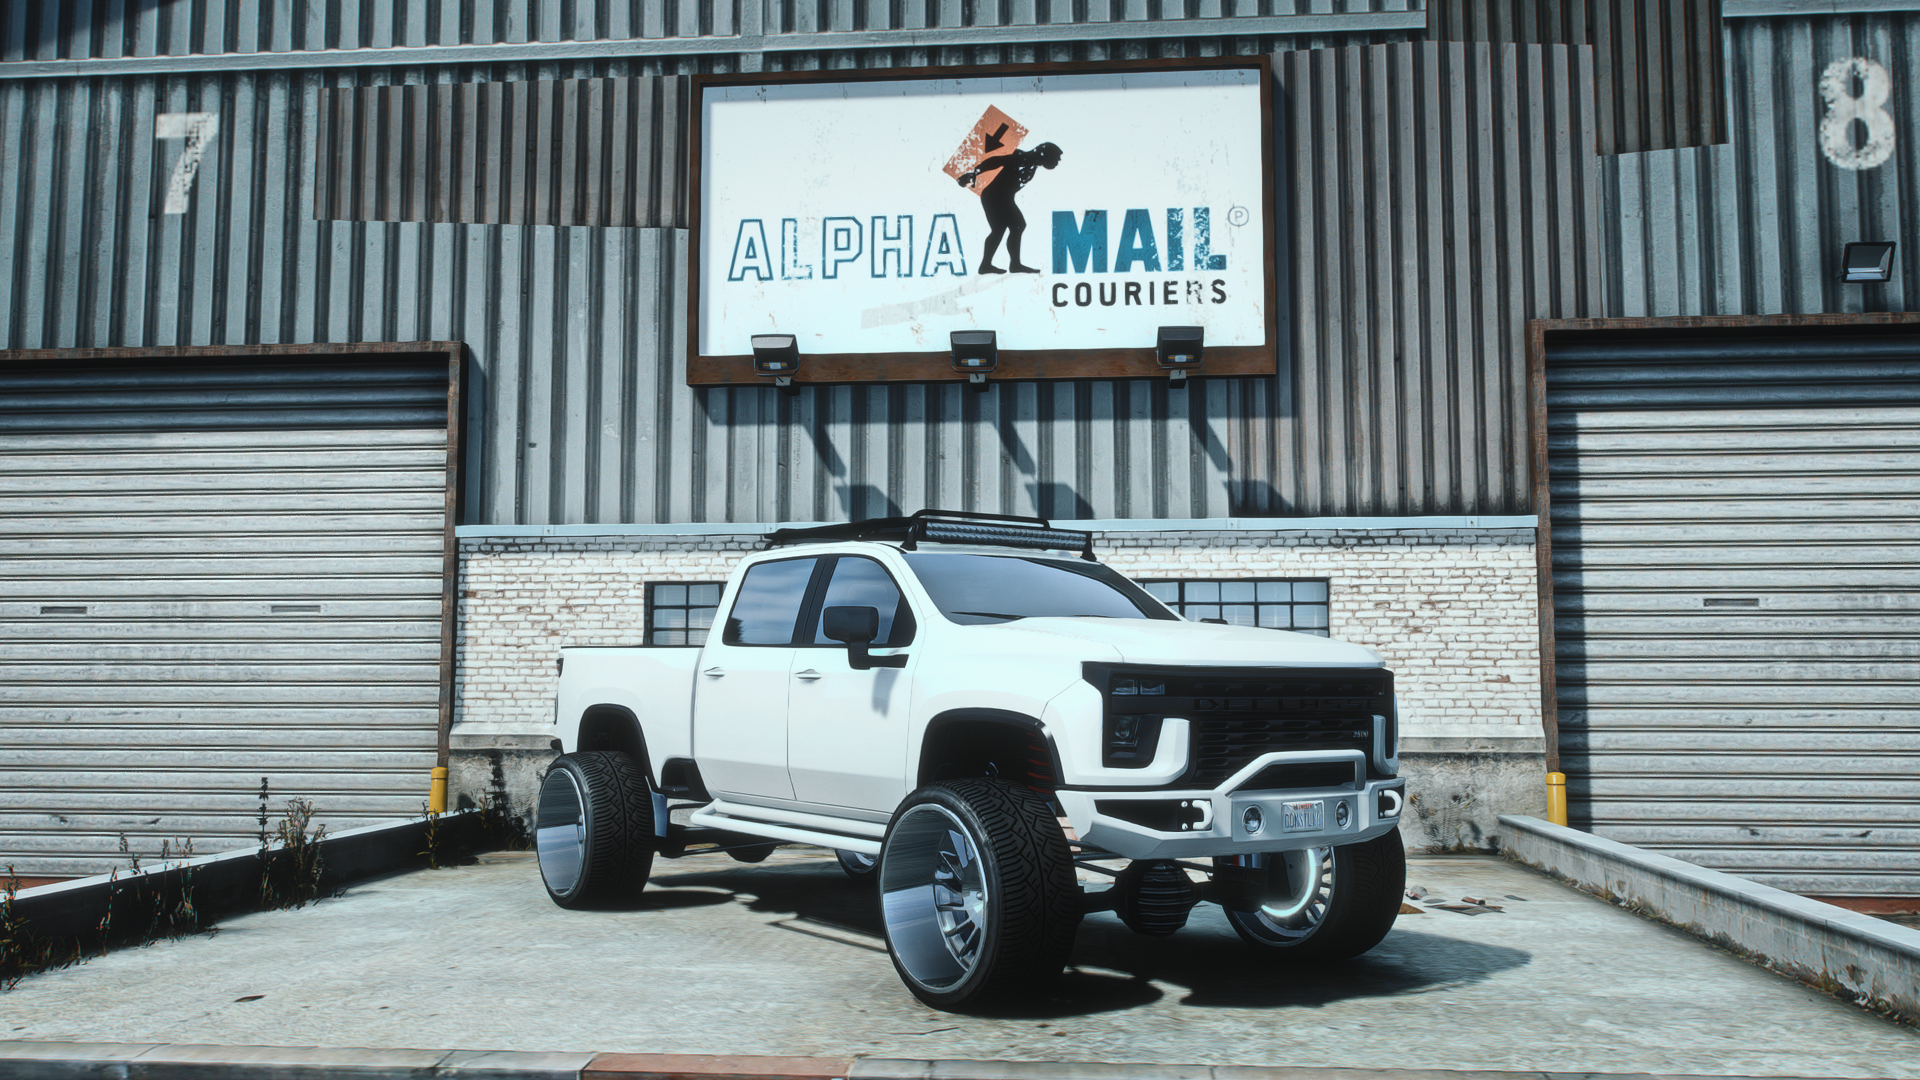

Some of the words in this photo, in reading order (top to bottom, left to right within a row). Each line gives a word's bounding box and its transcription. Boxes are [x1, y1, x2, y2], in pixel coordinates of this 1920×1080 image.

[1819, 57, 1895, 170] 8
[155, 112, 219, 214] 7
[728, 214, 967, 281] ALPHA
[1052, 207, 1227, 274] MAIL
[1052, 280, 1227, 308] COURIERS
